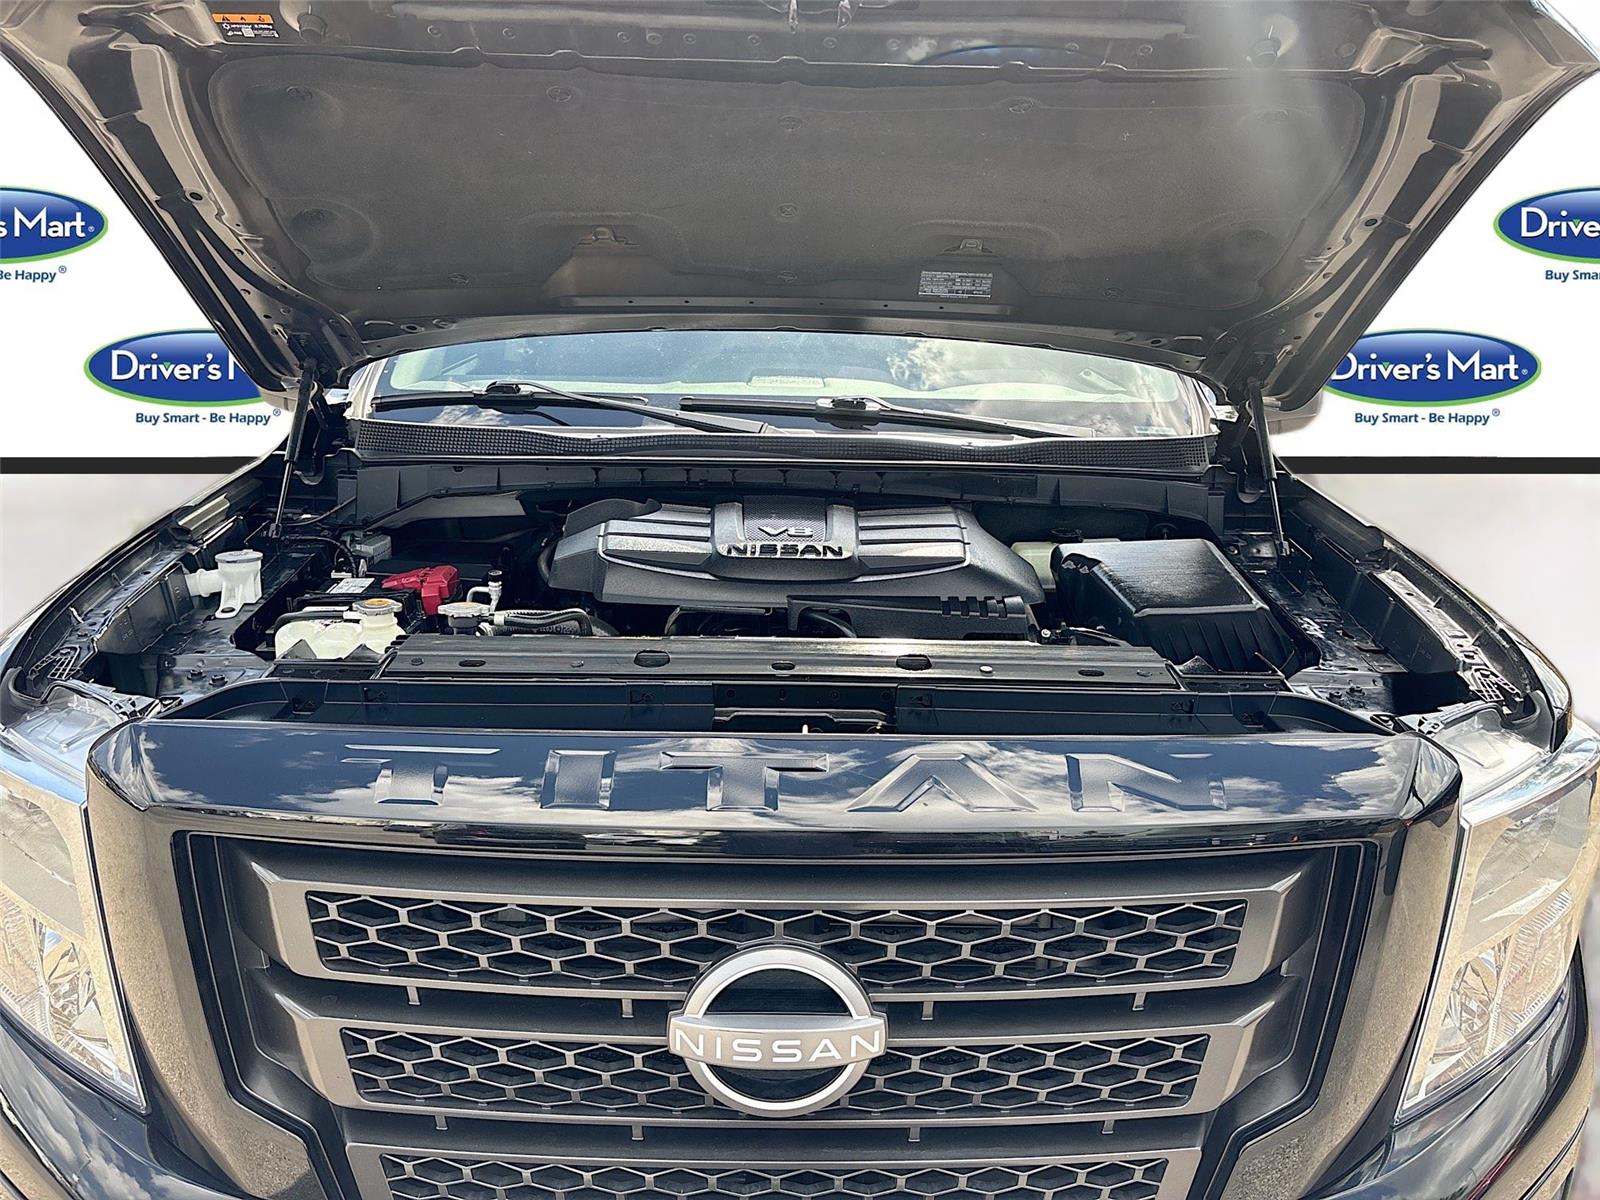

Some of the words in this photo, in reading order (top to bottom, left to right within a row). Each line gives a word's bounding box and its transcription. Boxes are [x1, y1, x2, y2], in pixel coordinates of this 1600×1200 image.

[14, 207, 86, 238] Mart
[15, 270, 56, 283] Happy
[1545, 269, 1570, 283] Buy
[1572, 269, 1600, 280] Sma
[111, 349, 222, 381] Driver's
[1331, 350, 1441, 381] Driver's
[1447, 349, 1519, 381] Mart
[135, 412, 160, 426] Buy
[163, 412, 200, 423] Smart
[209, 412, 226, 423] Be
[229, 412, 271, 426] Happy
[1354, 412, 1379, 426] Buy
[1382, 412, 1418, 423] Smart
[1428, 412, 1445, 423] Be
[1448, 412, 1490, 426] Happy
[758, 525, 814, 538] V8
[727, 543, 843, 558] NISSAN
[341, 743, 1229, 814] TITAN
[675, 1028, 881, 1063] NISSAN
